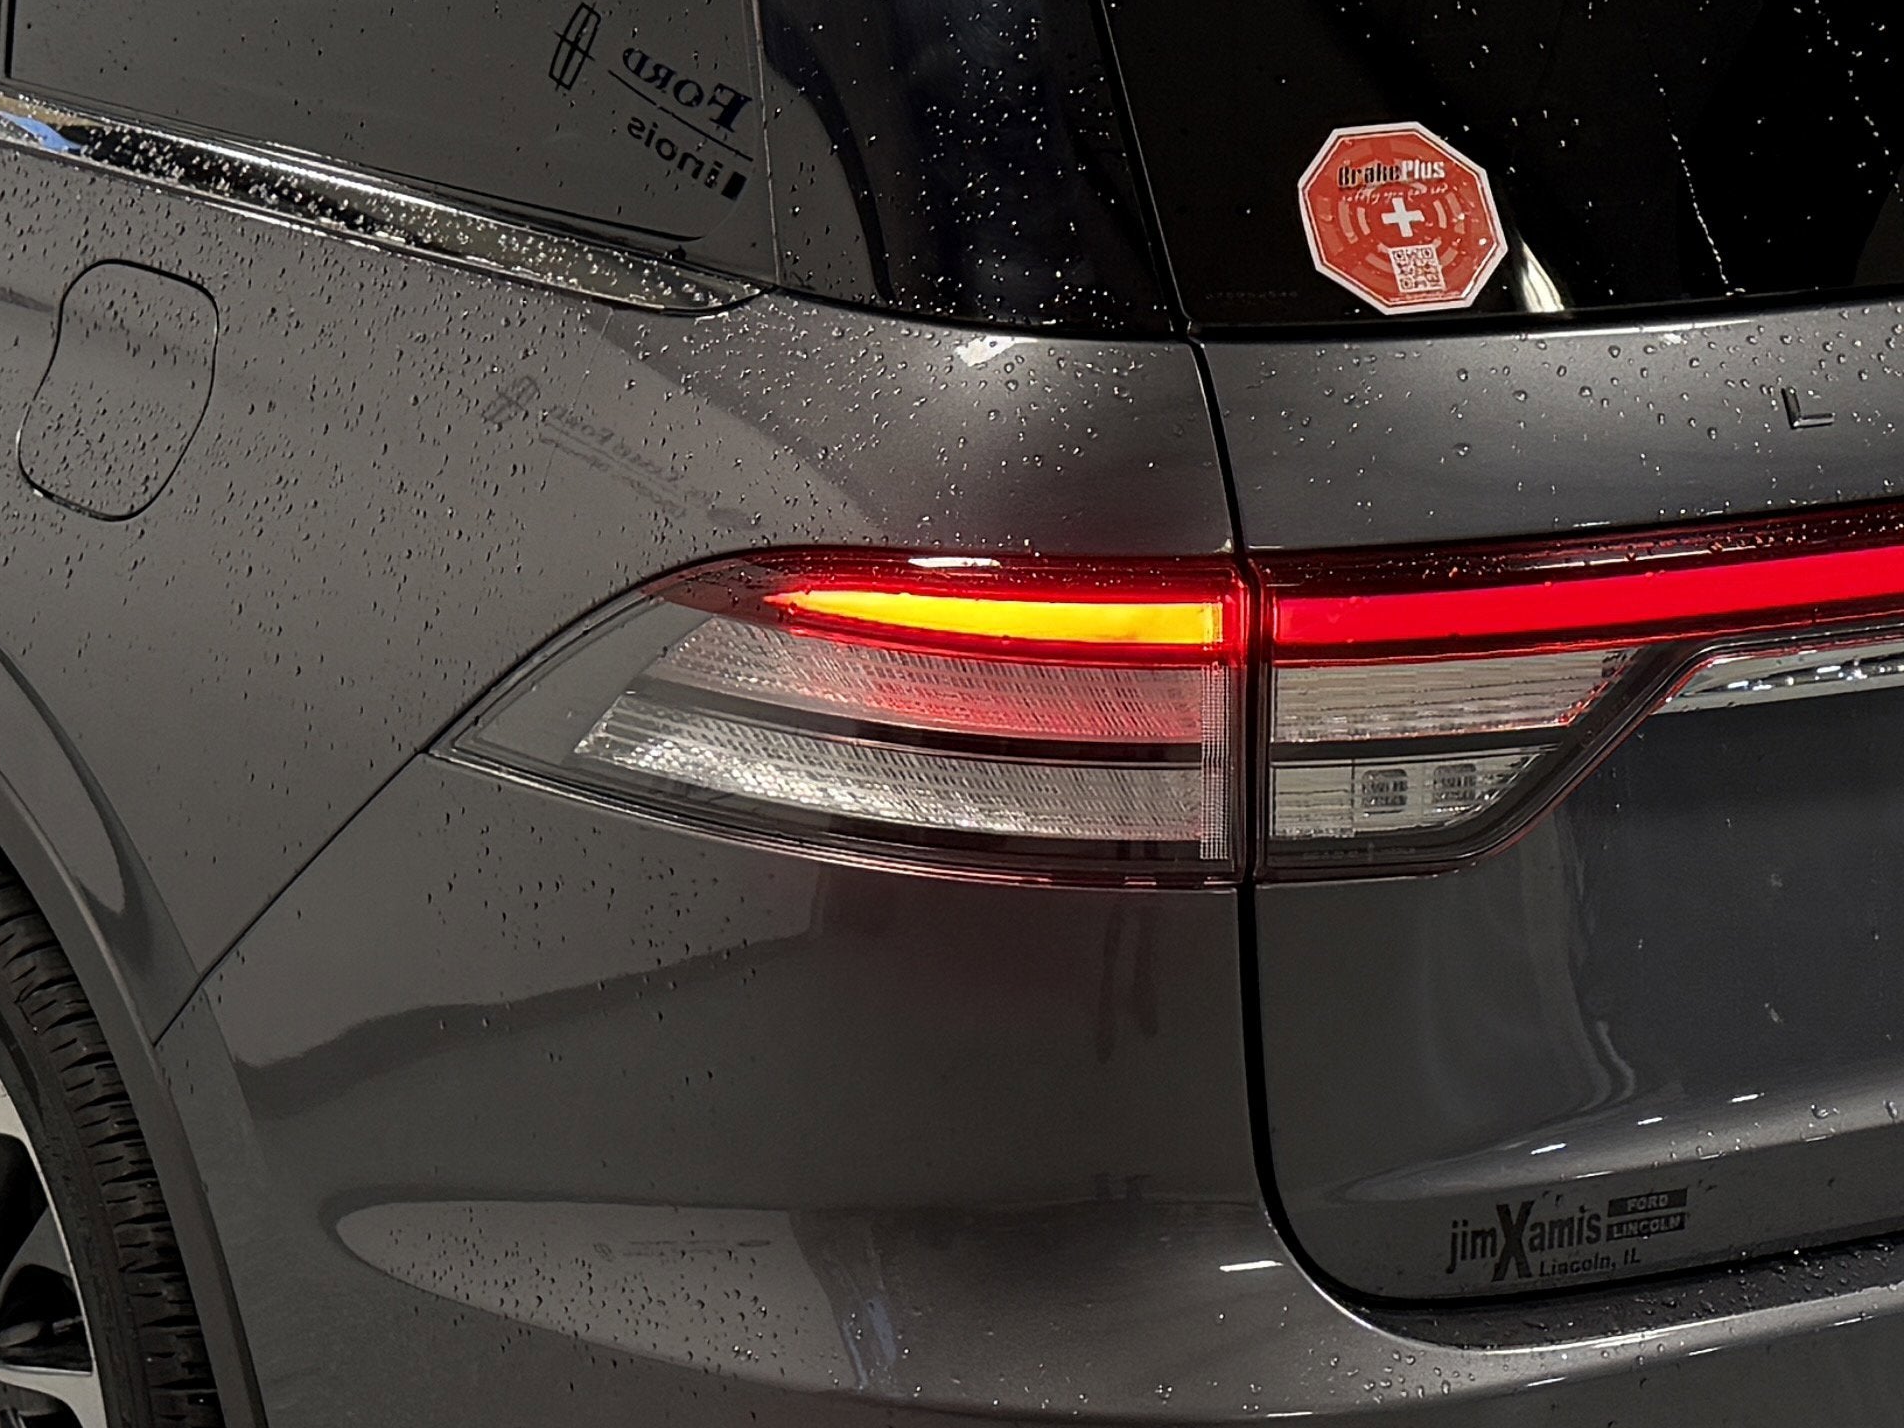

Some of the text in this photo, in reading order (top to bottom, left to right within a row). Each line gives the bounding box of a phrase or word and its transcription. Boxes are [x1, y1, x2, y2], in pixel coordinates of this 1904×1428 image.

[1338, 159, 1446, 189] BrakePlus
[1626, 1194, 1669, 1212] FORD
[1446, 1199, 1602, 1283] jimXamis
[1611, 1214, 1682, 1238] LINCOLN
[1539, 1248, 1642, 1278] Lincoln, IL
